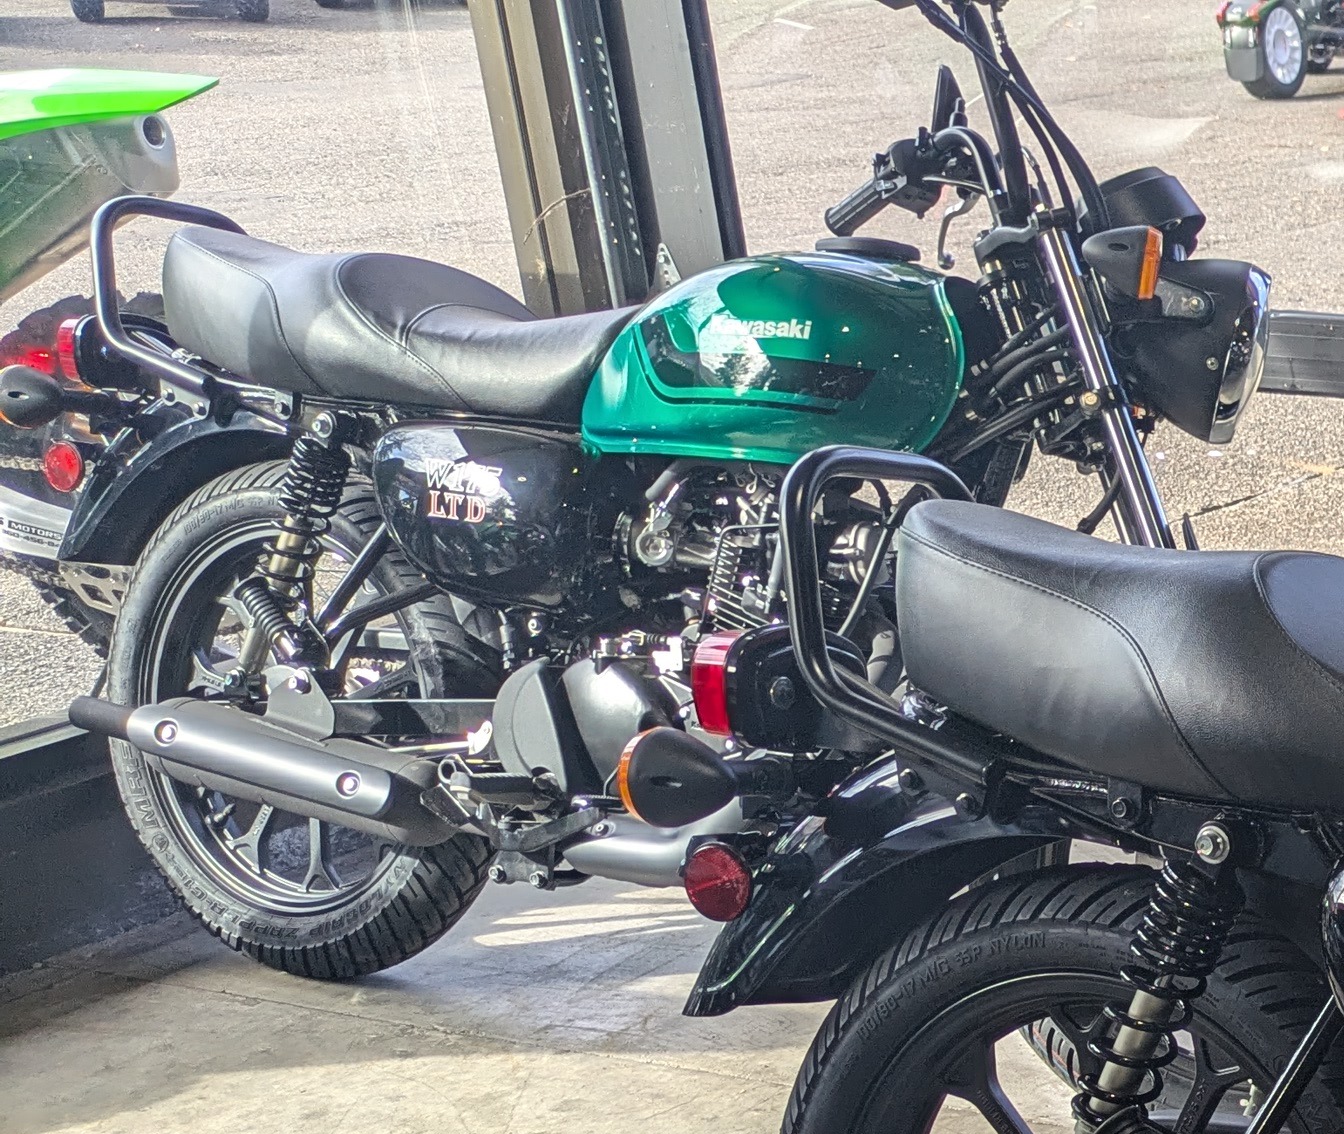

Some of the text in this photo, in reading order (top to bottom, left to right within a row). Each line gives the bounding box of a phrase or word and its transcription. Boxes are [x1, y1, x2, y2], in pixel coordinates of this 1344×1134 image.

[426, 489, 486, 524] LTD
[10, 521, 63, 541] MOTORS
[988, 932, 1047, 958] NYLON
